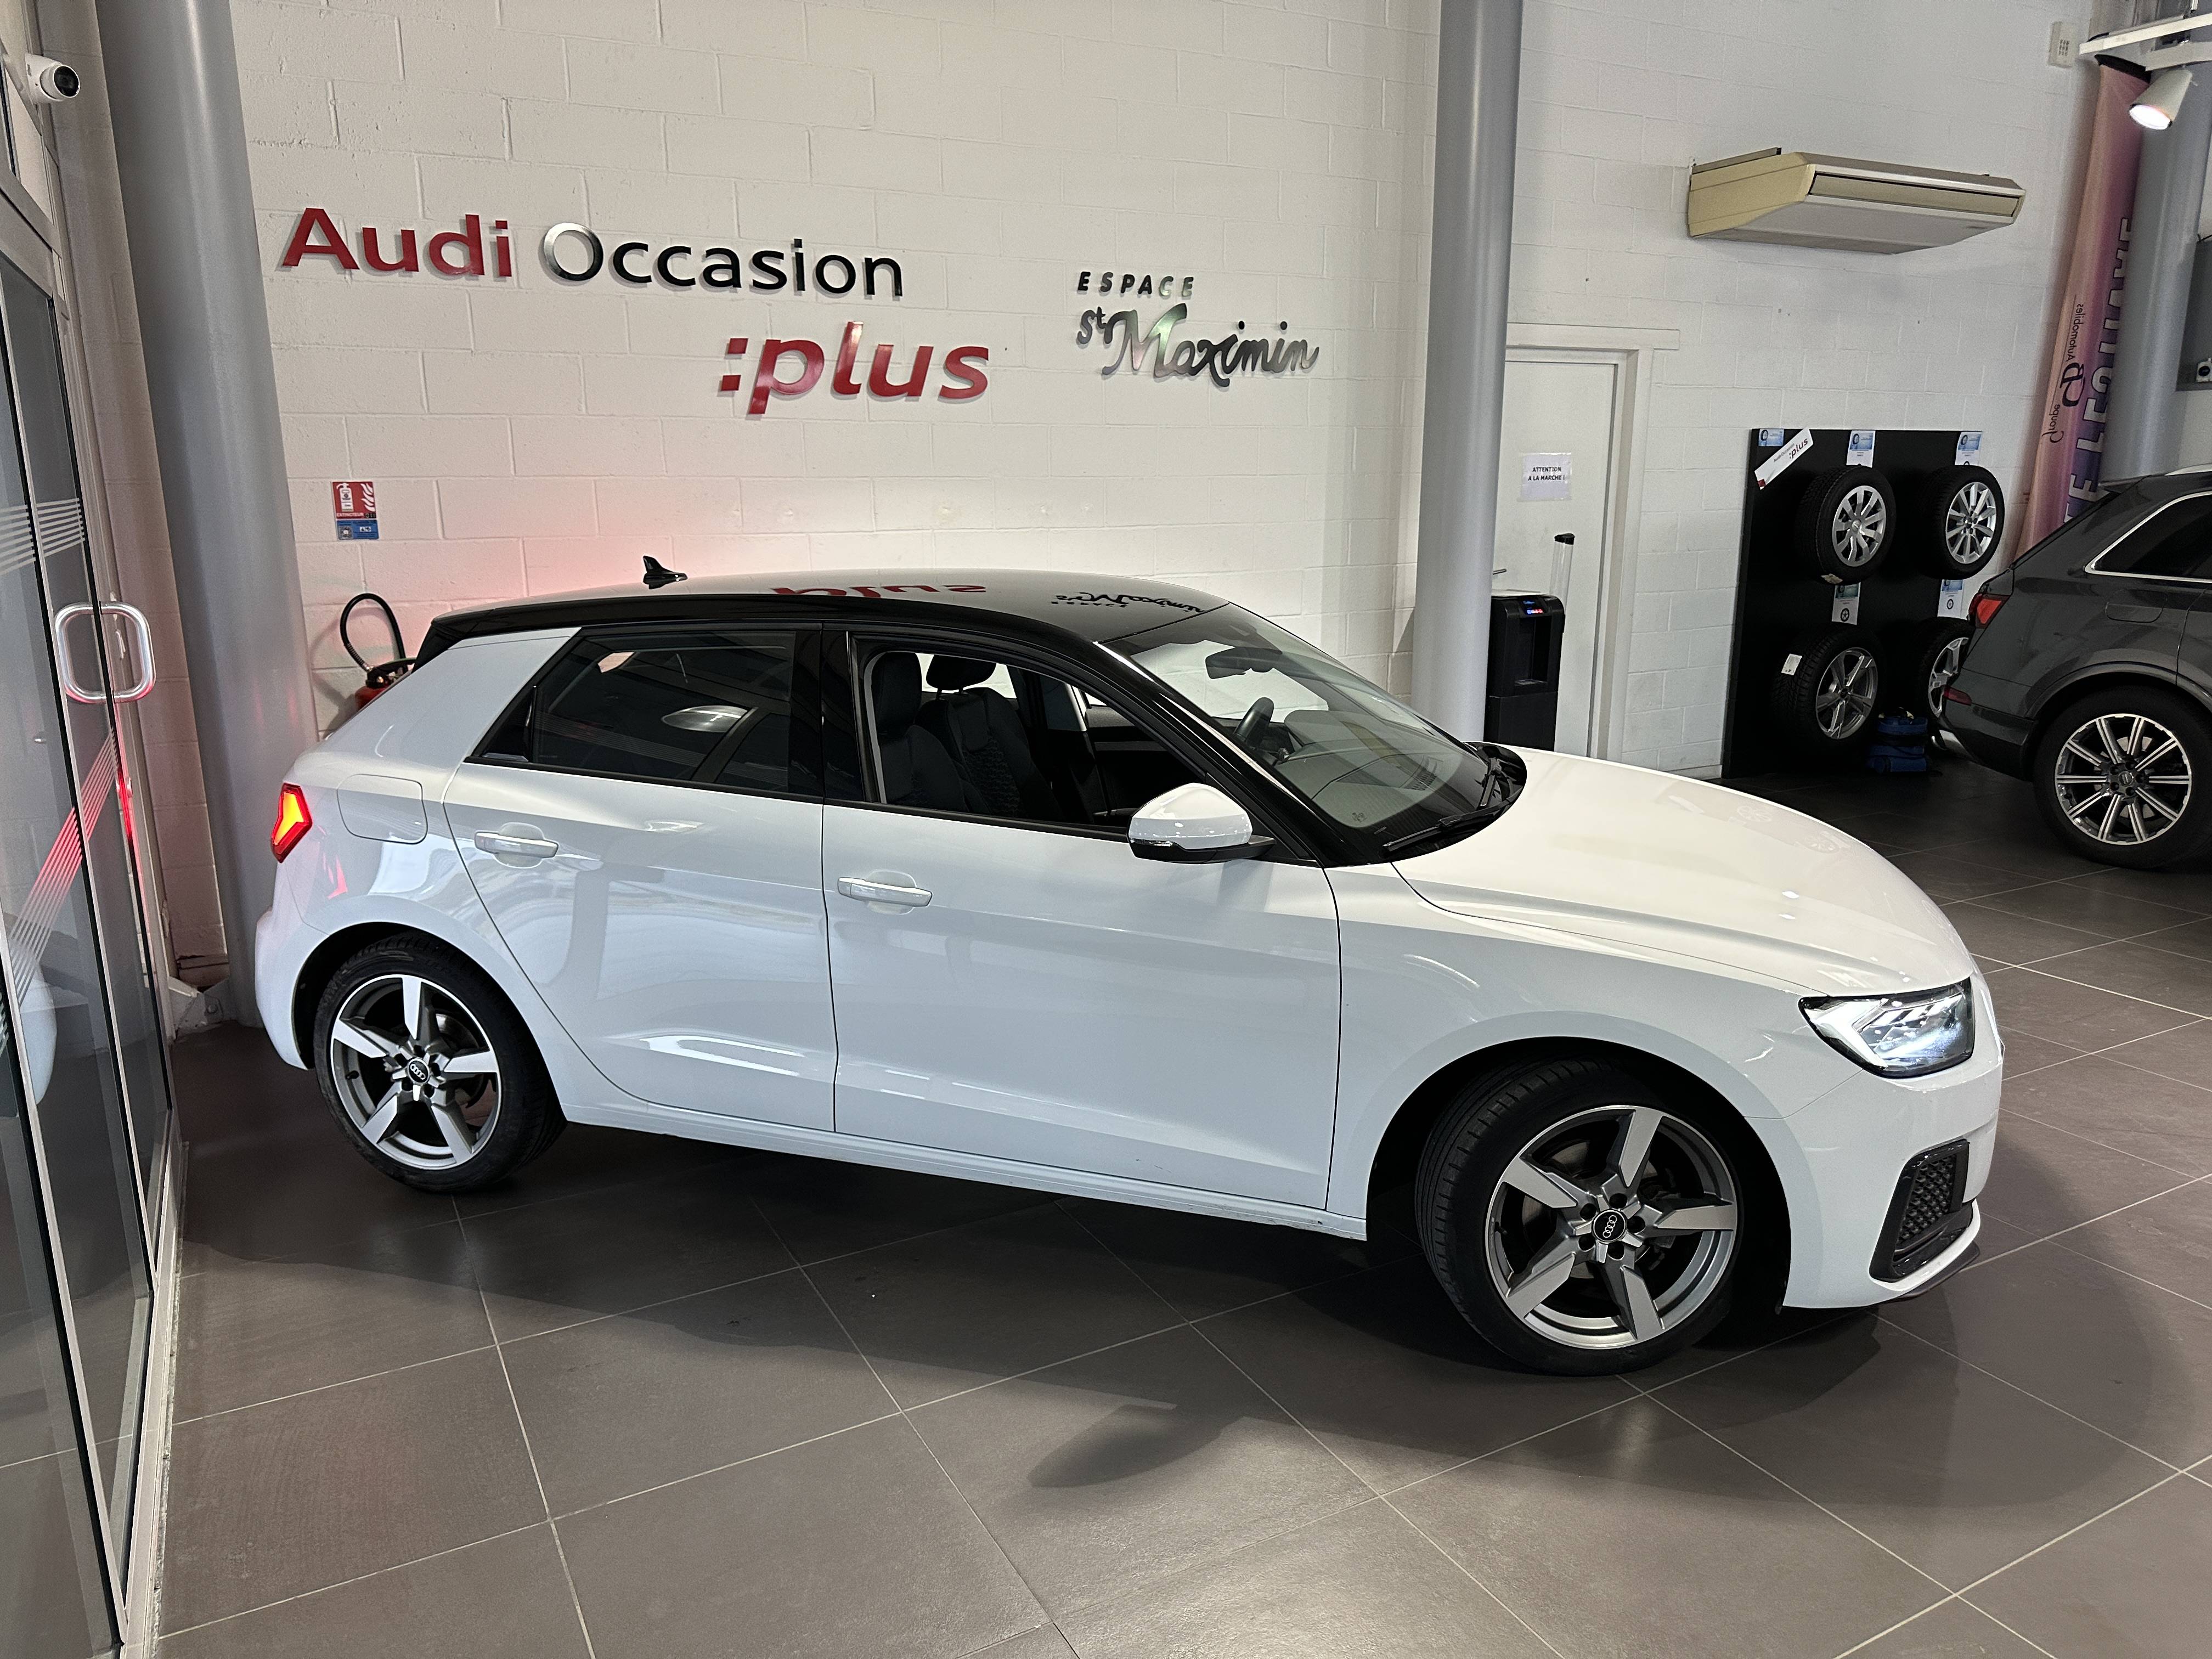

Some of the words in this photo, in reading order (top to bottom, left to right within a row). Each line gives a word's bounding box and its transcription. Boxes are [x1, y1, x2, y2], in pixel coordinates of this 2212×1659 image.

[282, 207, 512, 277] Audi
[544, 222, 903, 297] Occasion
[1077, 272, 1194, 297] ESPACE
[1102, 303, 1319, 387] Maximin
